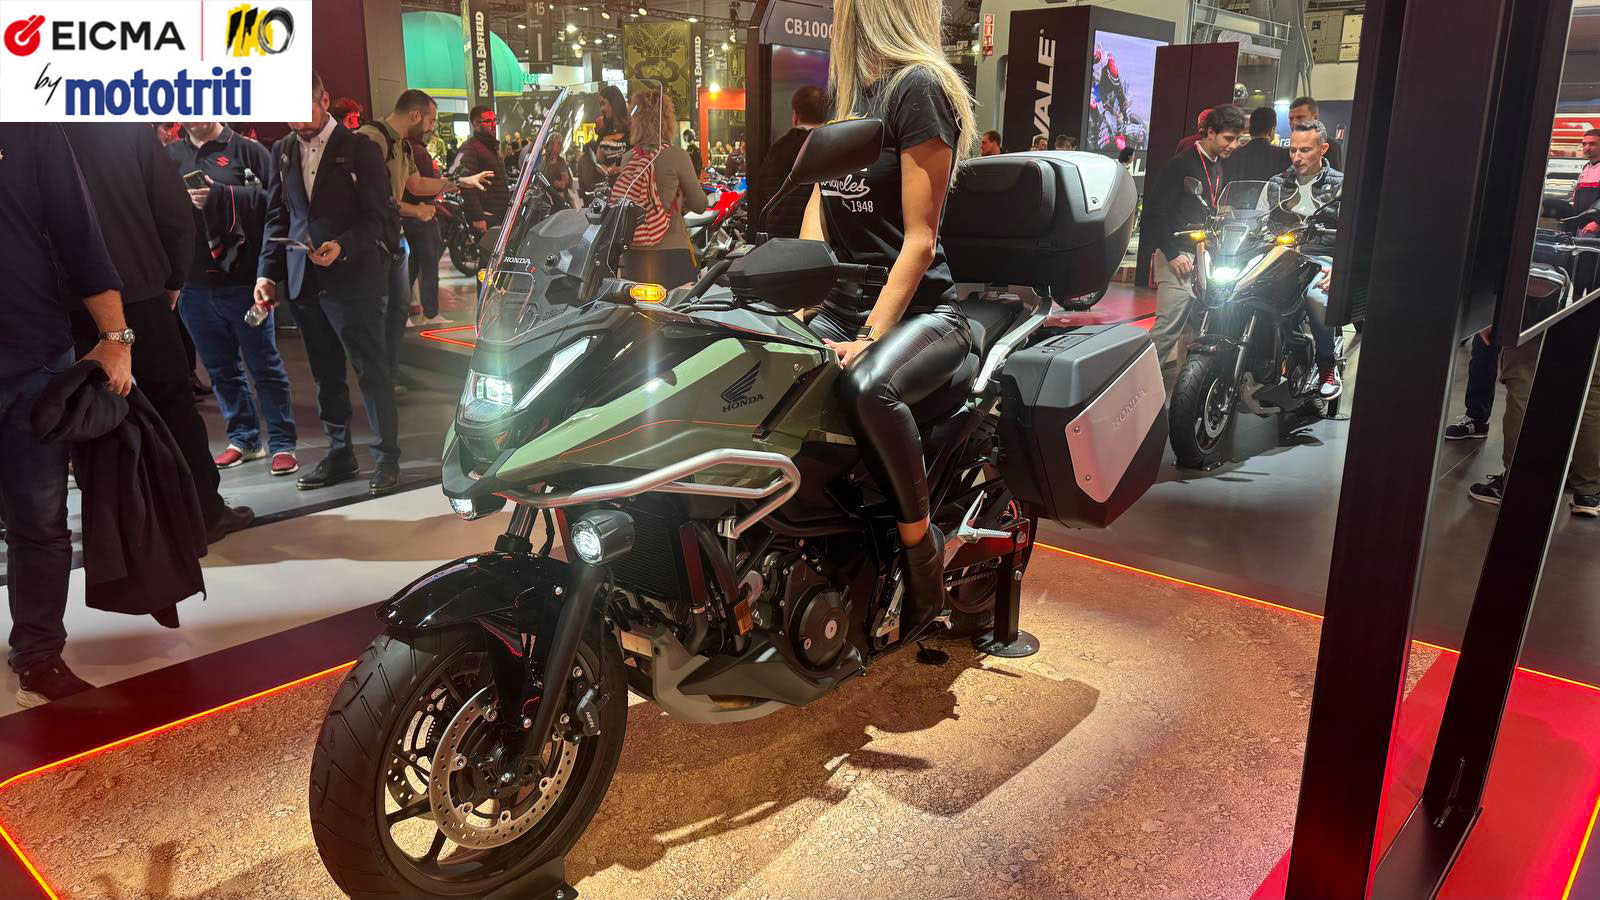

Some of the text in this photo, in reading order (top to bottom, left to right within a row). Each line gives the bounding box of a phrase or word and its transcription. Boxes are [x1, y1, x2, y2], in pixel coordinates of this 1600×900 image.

[534, 2, 546, 16] 15
[475, 10, 489, 98] ROYAL ENFIELD
[850, 200, 874, 213] 1948
[503, 256, 532, 264] HONDA
[722, 393, 765, 413] HONDA
